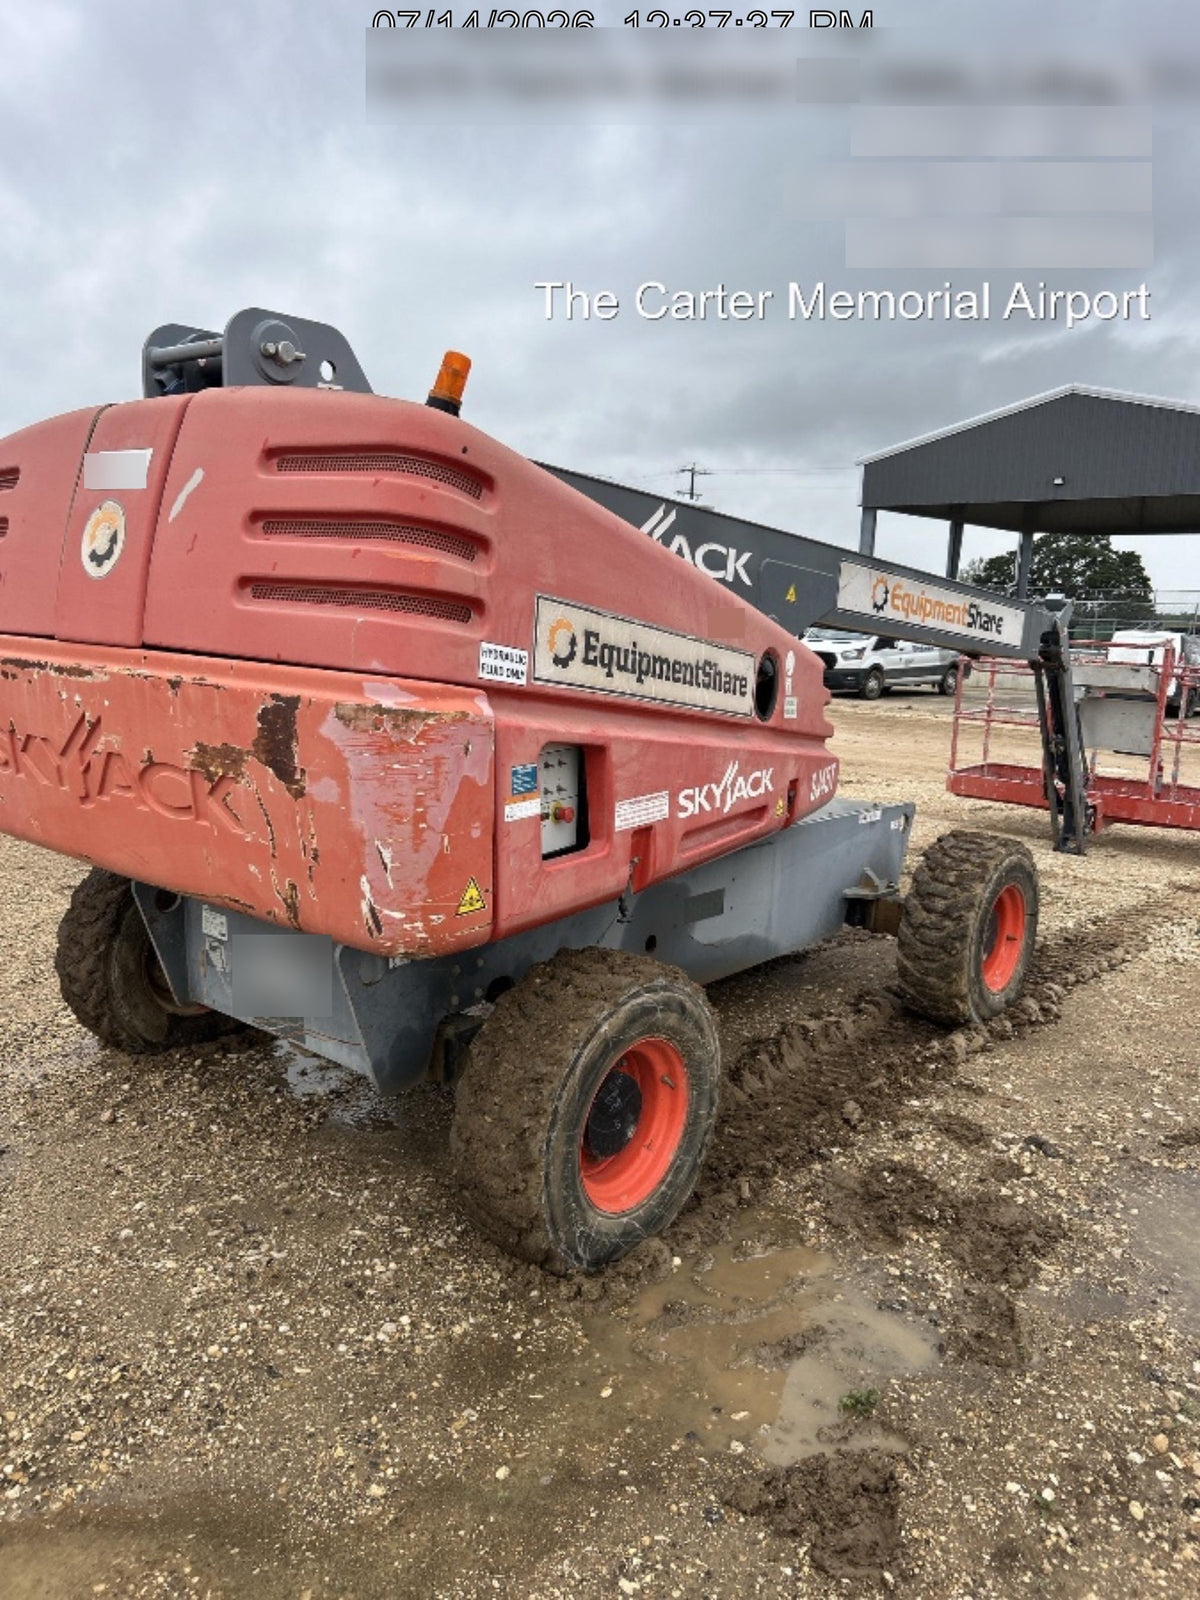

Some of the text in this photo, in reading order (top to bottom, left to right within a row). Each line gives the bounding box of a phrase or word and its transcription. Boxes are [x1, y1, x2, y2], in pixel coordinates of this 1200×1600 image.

[890, 581, 1004, 635] EquipmentShare
[582, 628, 748, 699] EquipmentShare
[677, 760, 775, 819] SKYJACK
